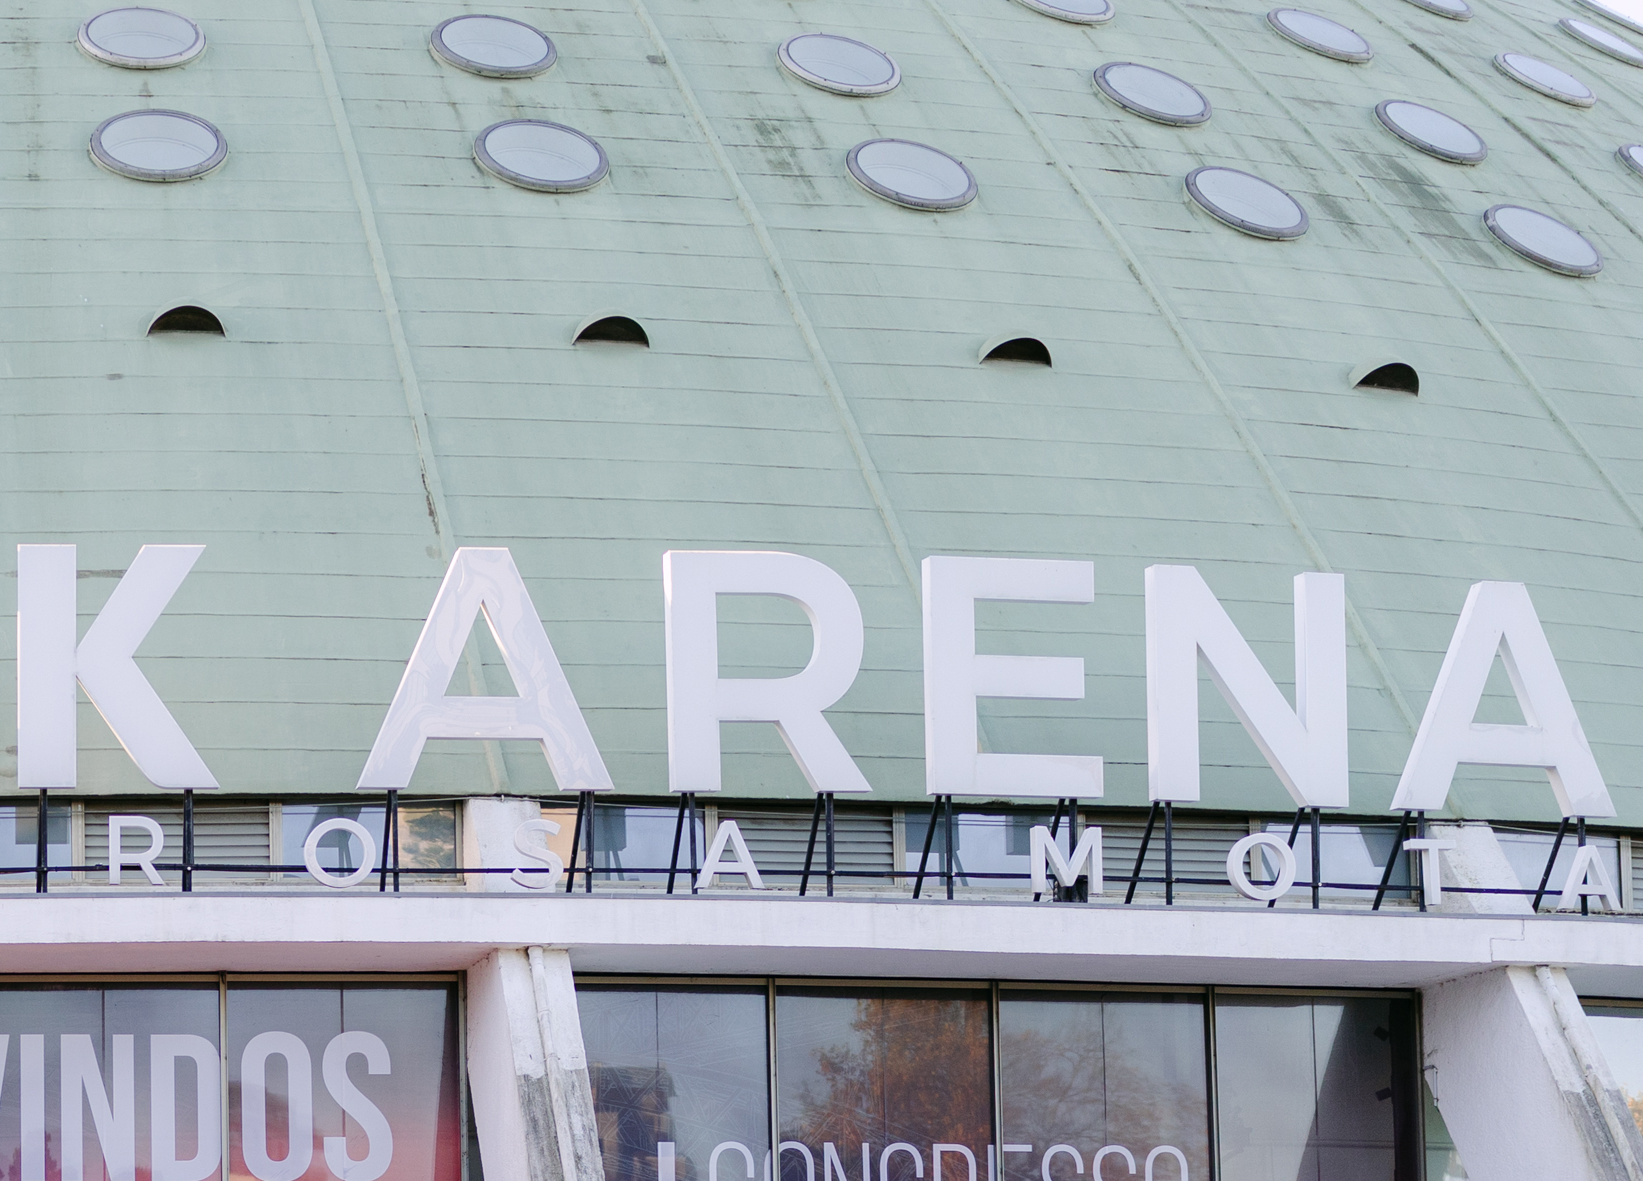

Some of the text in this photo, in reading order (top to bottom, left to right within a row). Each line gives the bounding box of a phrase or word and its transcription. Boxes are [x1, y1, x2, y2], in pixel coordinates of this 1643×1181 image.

[356, 545, 1617, 818] ARENA
[108, 815, 765, 889] ROSA
[1030, 824, 1623, 912] MOTA
